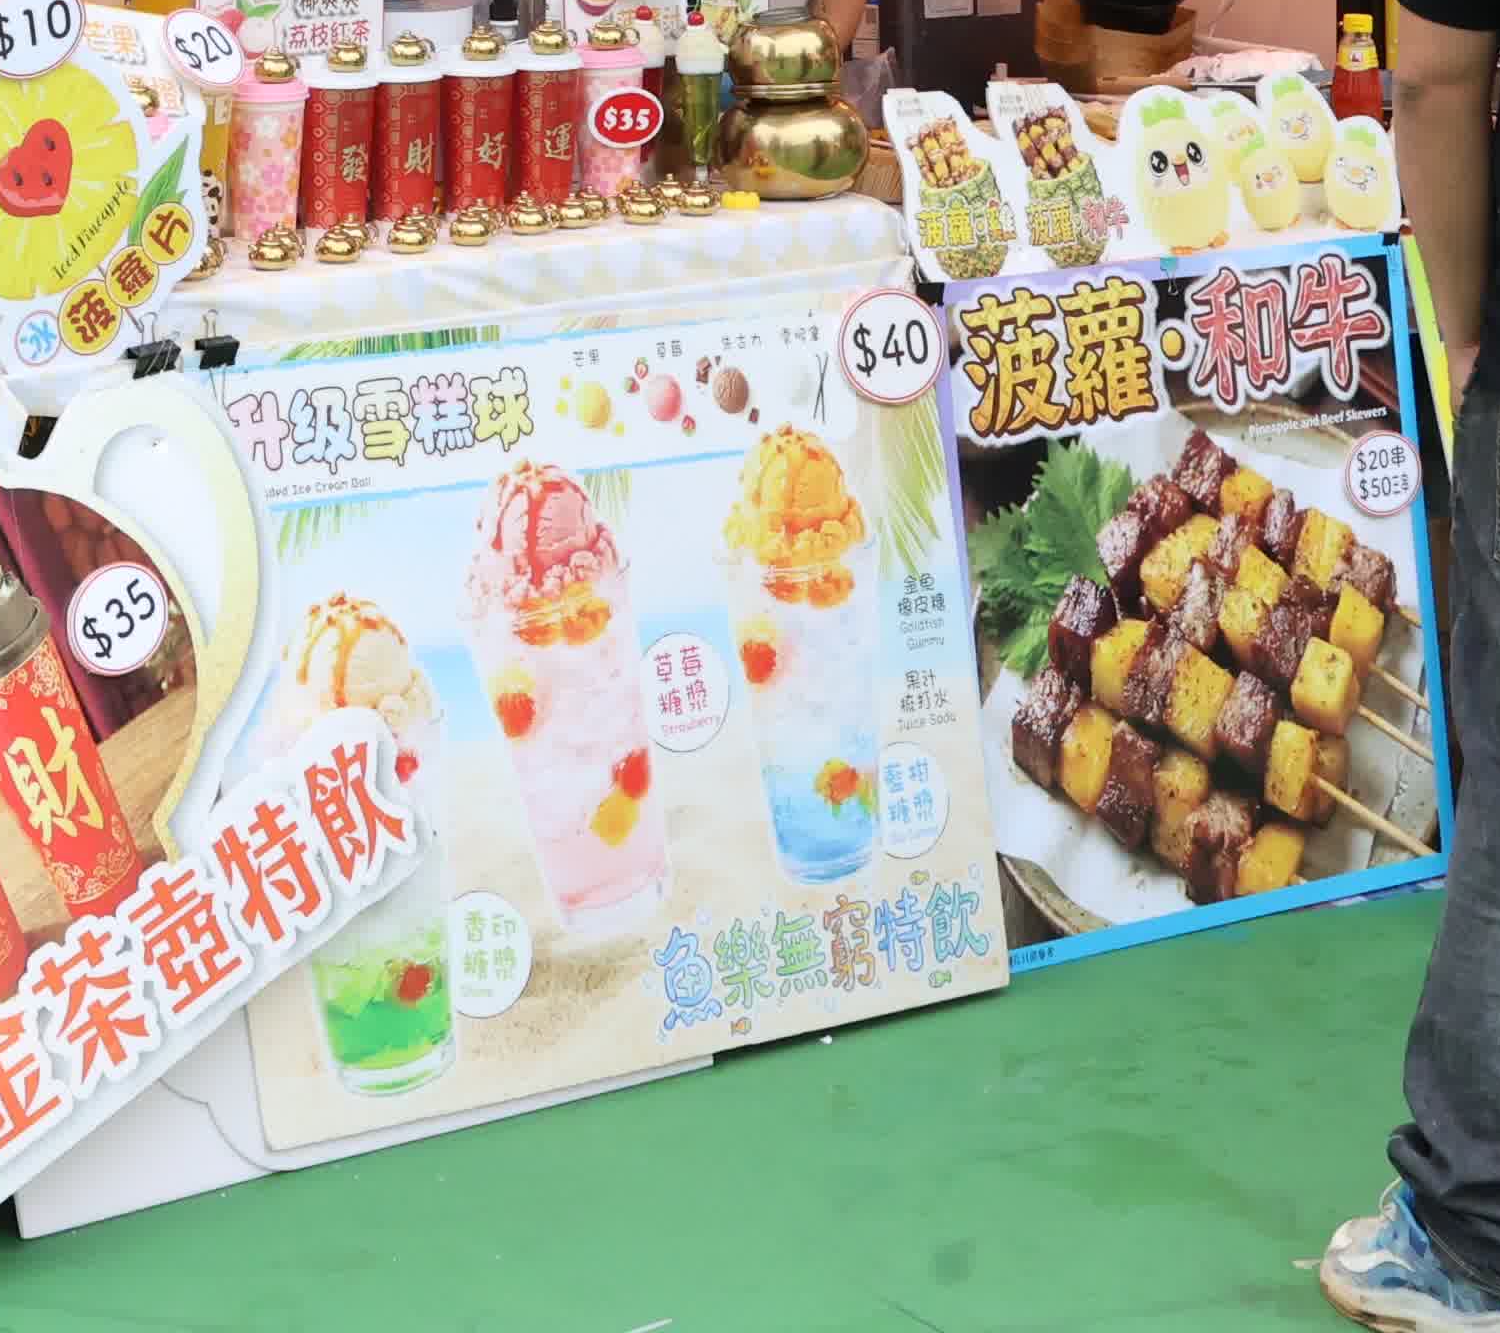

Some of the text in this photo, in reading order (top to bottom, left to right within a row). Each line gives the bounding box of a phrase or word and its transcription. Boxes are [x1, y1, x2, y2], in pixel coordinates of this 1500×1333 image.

[174, 29, 232, 70] $20
[288, 18, 370, 48] 荔枝紅茶
[602, 106, 651, 133] $35
[403, 138, 434, 175] 財
[474, 135, 508, 169] 好
[544, 121, 573, 160] 運
[340, 143, 370, 184] 發
[78, 178, 132, 253] Pineapple
[19, 212, 186, 359] 冰菠蘿片
[854, 319, 928, 376] $40
[1248, 406, 1388, 438] Pineapple and Beef Skewers
[1356, 444, 1406, 473] $20串
[292, 483, 311, 497] Ice
[315, 480, 348, 495] Cream
[904, 573, 935, 595] 金魚
[80, 578, 158, 658] $35
[897, 592, 946, 615] 橡皮糖
[653, 645, 703, 683] 草莓
[904, 668, 936, 688] 果汁
[659, 679, 708, 717] 糖漿
[929, 712, 957, 726] Soda
[2, 703, 103, 842] 財
[658, 883, 989, 1033] 魚樂無窮特飲
